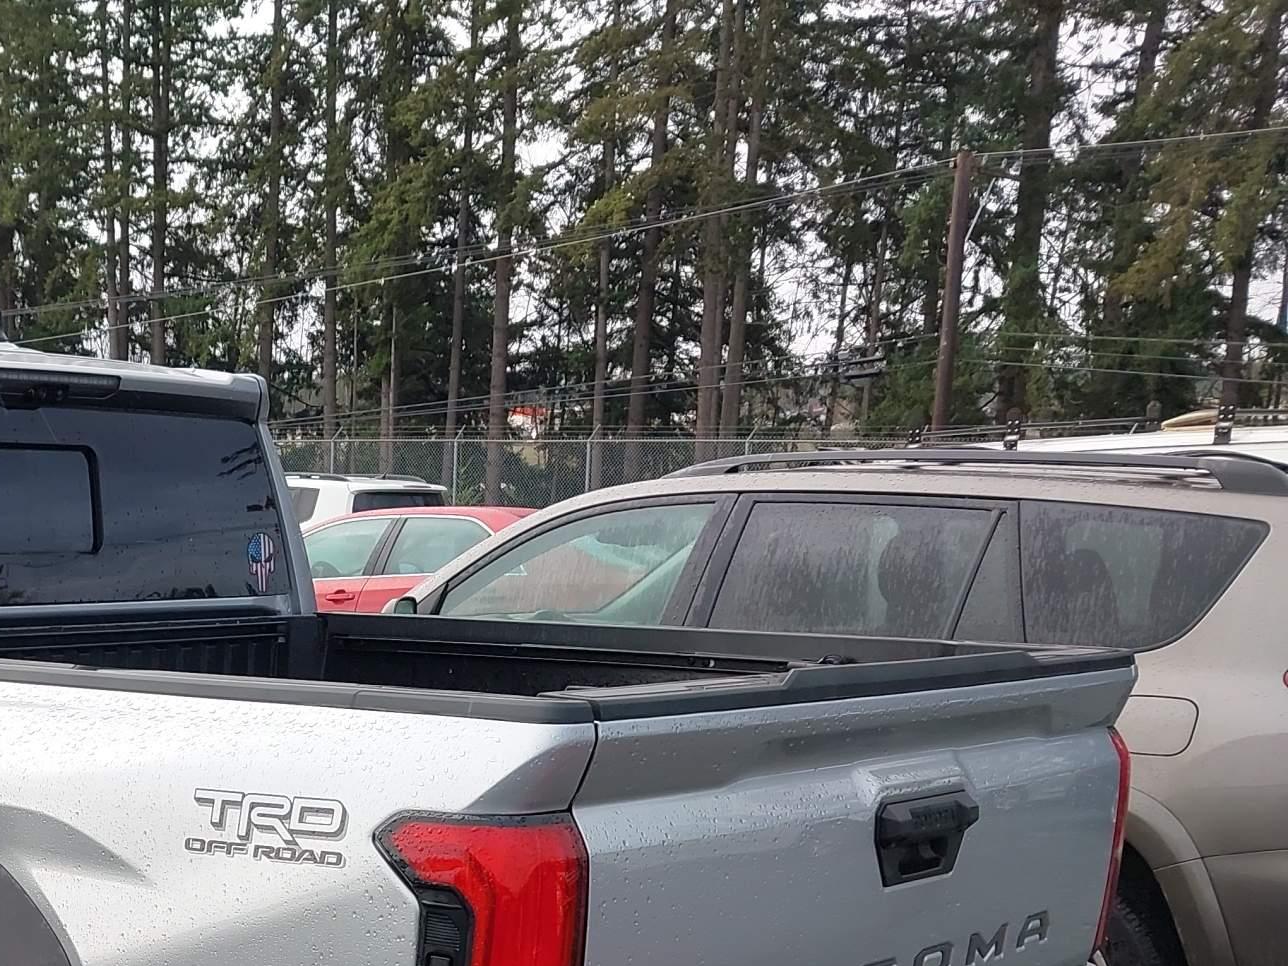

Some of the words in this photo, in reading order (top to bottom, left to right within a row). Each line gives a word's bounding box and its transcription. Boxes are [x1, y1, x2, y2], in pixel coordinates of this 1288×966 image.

[193, 787, 349, 849] TRD
[184, 836, 249, 858] OFF
[252, 844, 346, 868] ROAD
